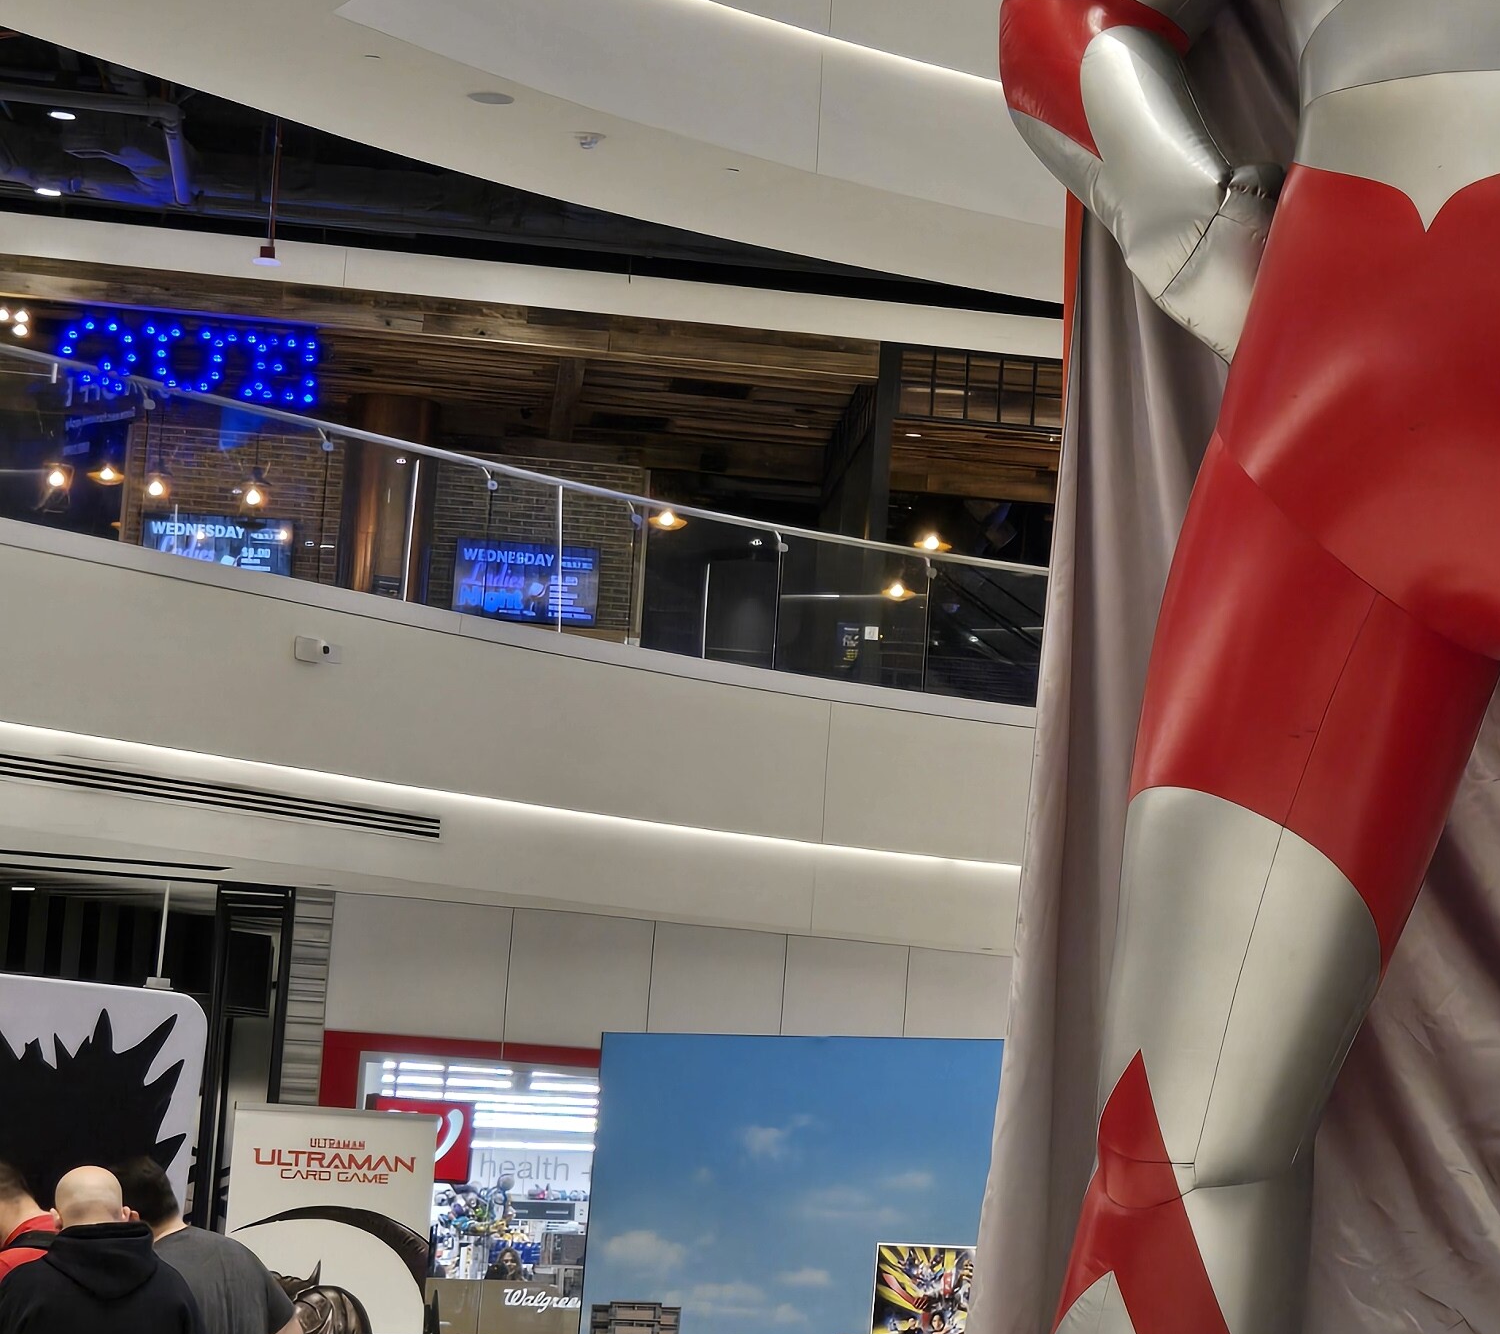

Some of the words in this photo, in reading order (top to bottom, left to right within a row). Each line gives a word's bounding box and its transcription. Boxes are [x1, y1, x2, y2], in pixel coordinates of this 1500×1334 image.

[151, 521, 245, 539] WEDNESDAY
[463, 548, 555, 567] WEDNESDAY
[253, 1147, 417, 1174] ULTRAMAN
[480, 1152, 569, 1181] health
[280, 1168, 331, 1181] CARD
[337, 1171, 389, 1185] GAME
